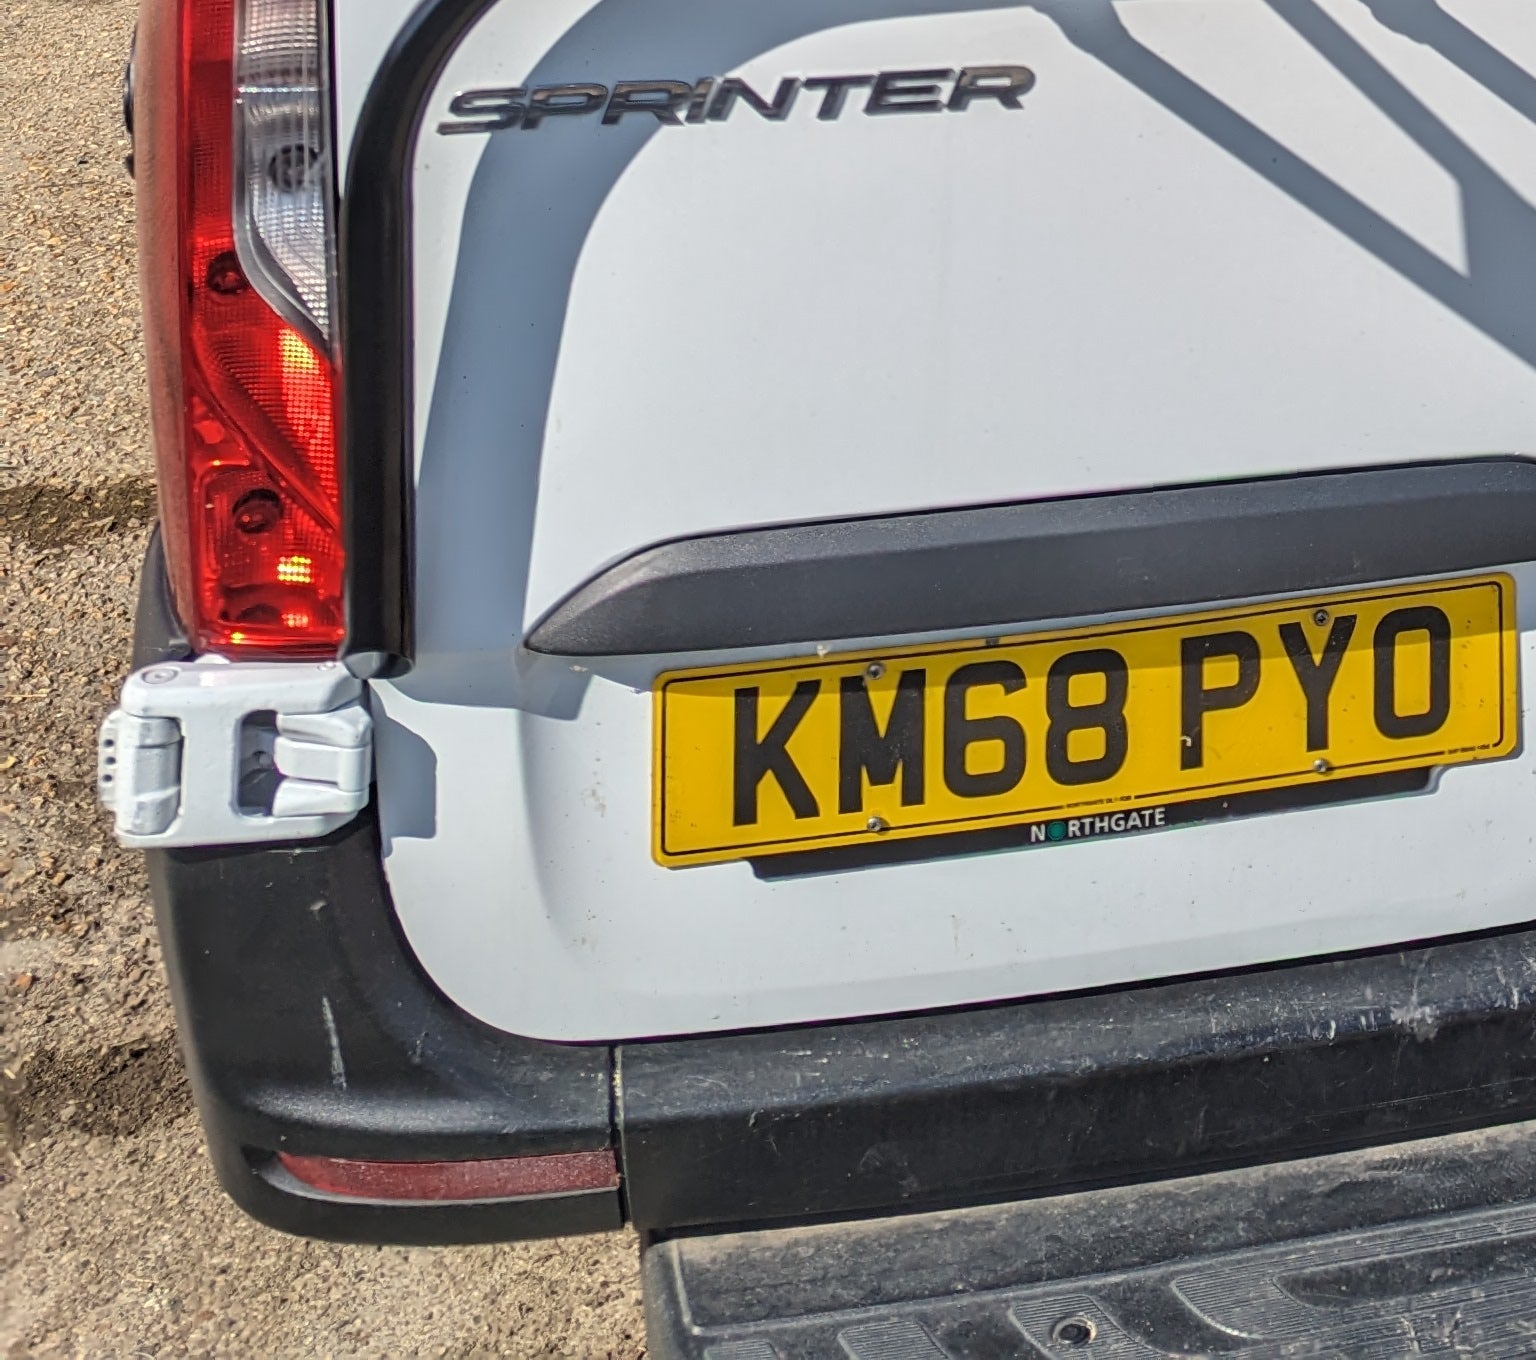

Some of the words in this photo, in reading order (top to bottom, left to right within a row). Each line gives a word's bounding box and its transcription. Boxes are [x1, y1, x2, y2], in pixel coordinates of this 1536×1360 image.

[436, 65, 1037, 135] SPRINTER
[732, 646, 1128, 826] KM68
[1030, 806, 1166, 843] NORTHGATE
